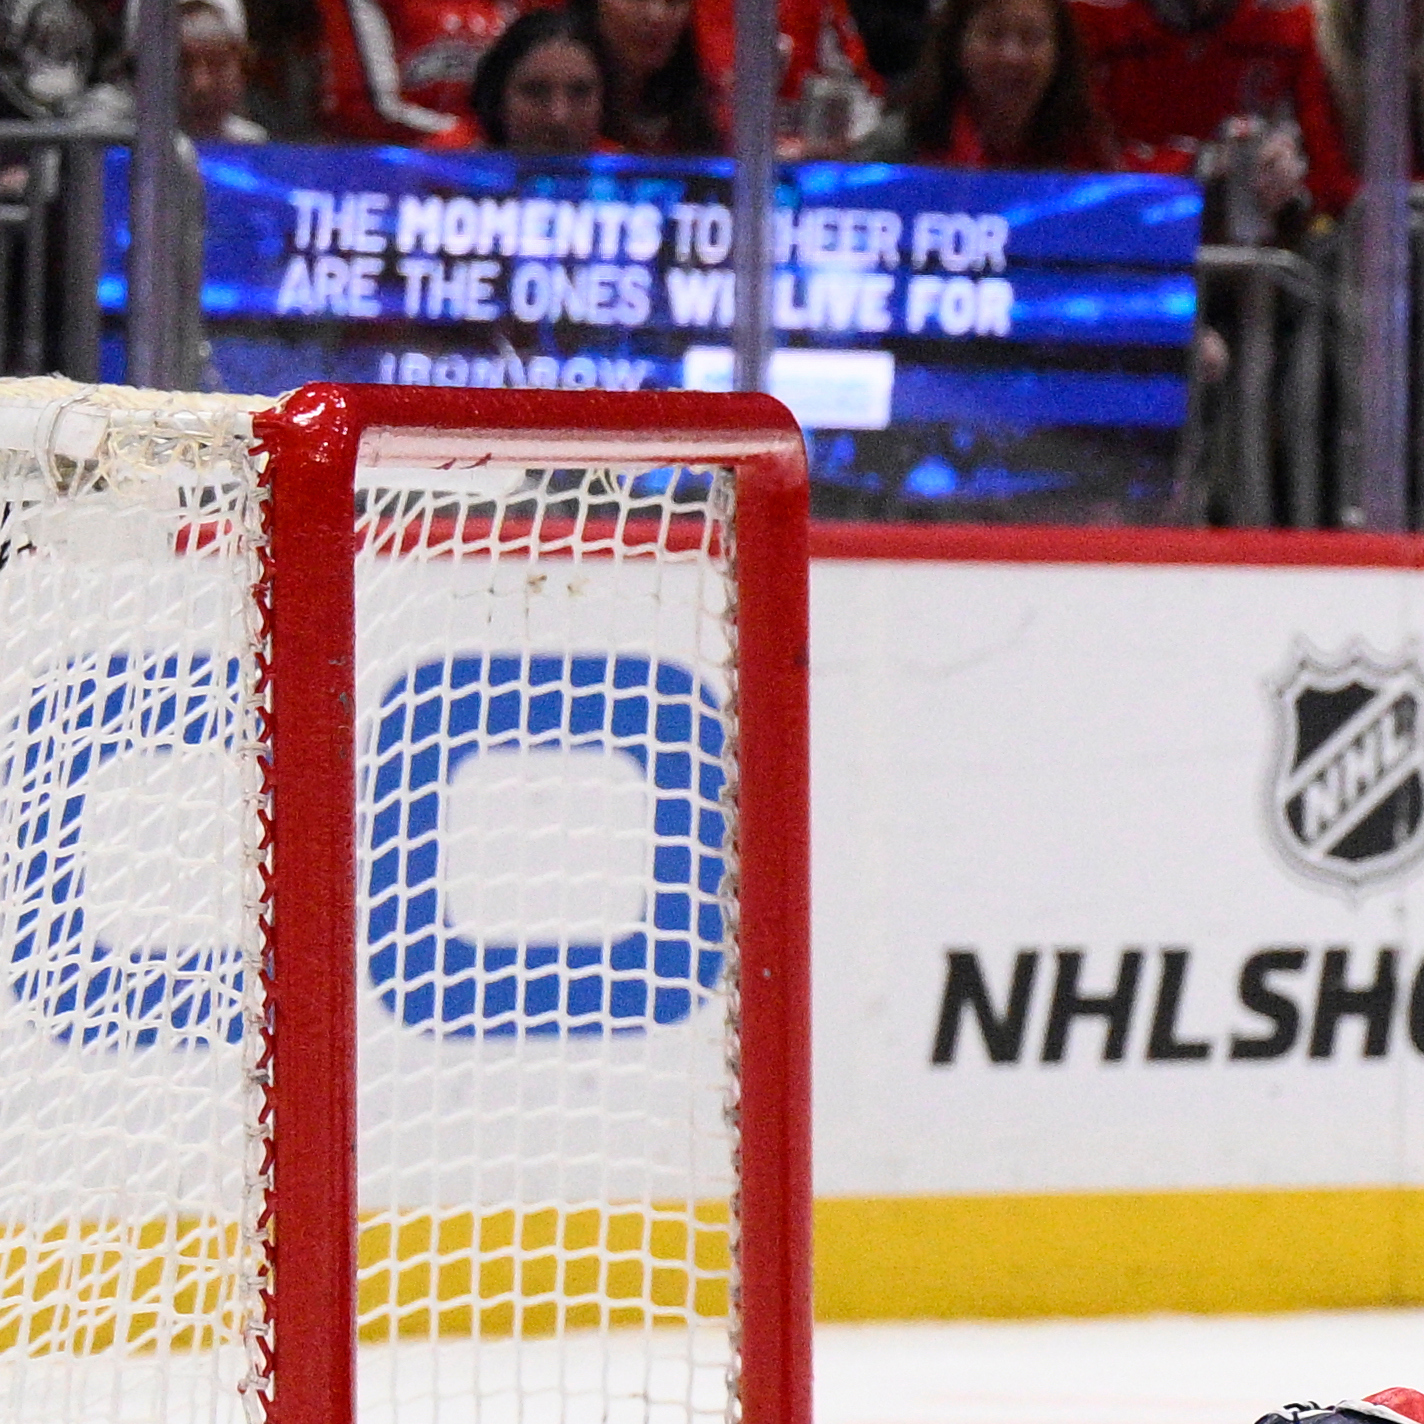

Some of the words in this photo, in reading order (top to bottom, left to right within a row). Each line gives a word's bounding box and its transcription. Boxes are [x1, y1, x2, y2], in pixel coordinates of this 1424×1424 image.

[290, 189, 390, 252] THE
[397, 195, 662, 261] MOMENTS
[670, 204, 734, 264] TO
[768, 207, 902, 271] HEER
[911, 212, 1009, 273] FOR
[275, 254, 384, 317] ARE
[396, 258, 500, 321] THE
[510, 261, 651, 326] ONES
[771, 270, 895, 332] LIVE
[904, 274, 1014, 338] FOR
[1302, 710, 1416, 841] NHL
